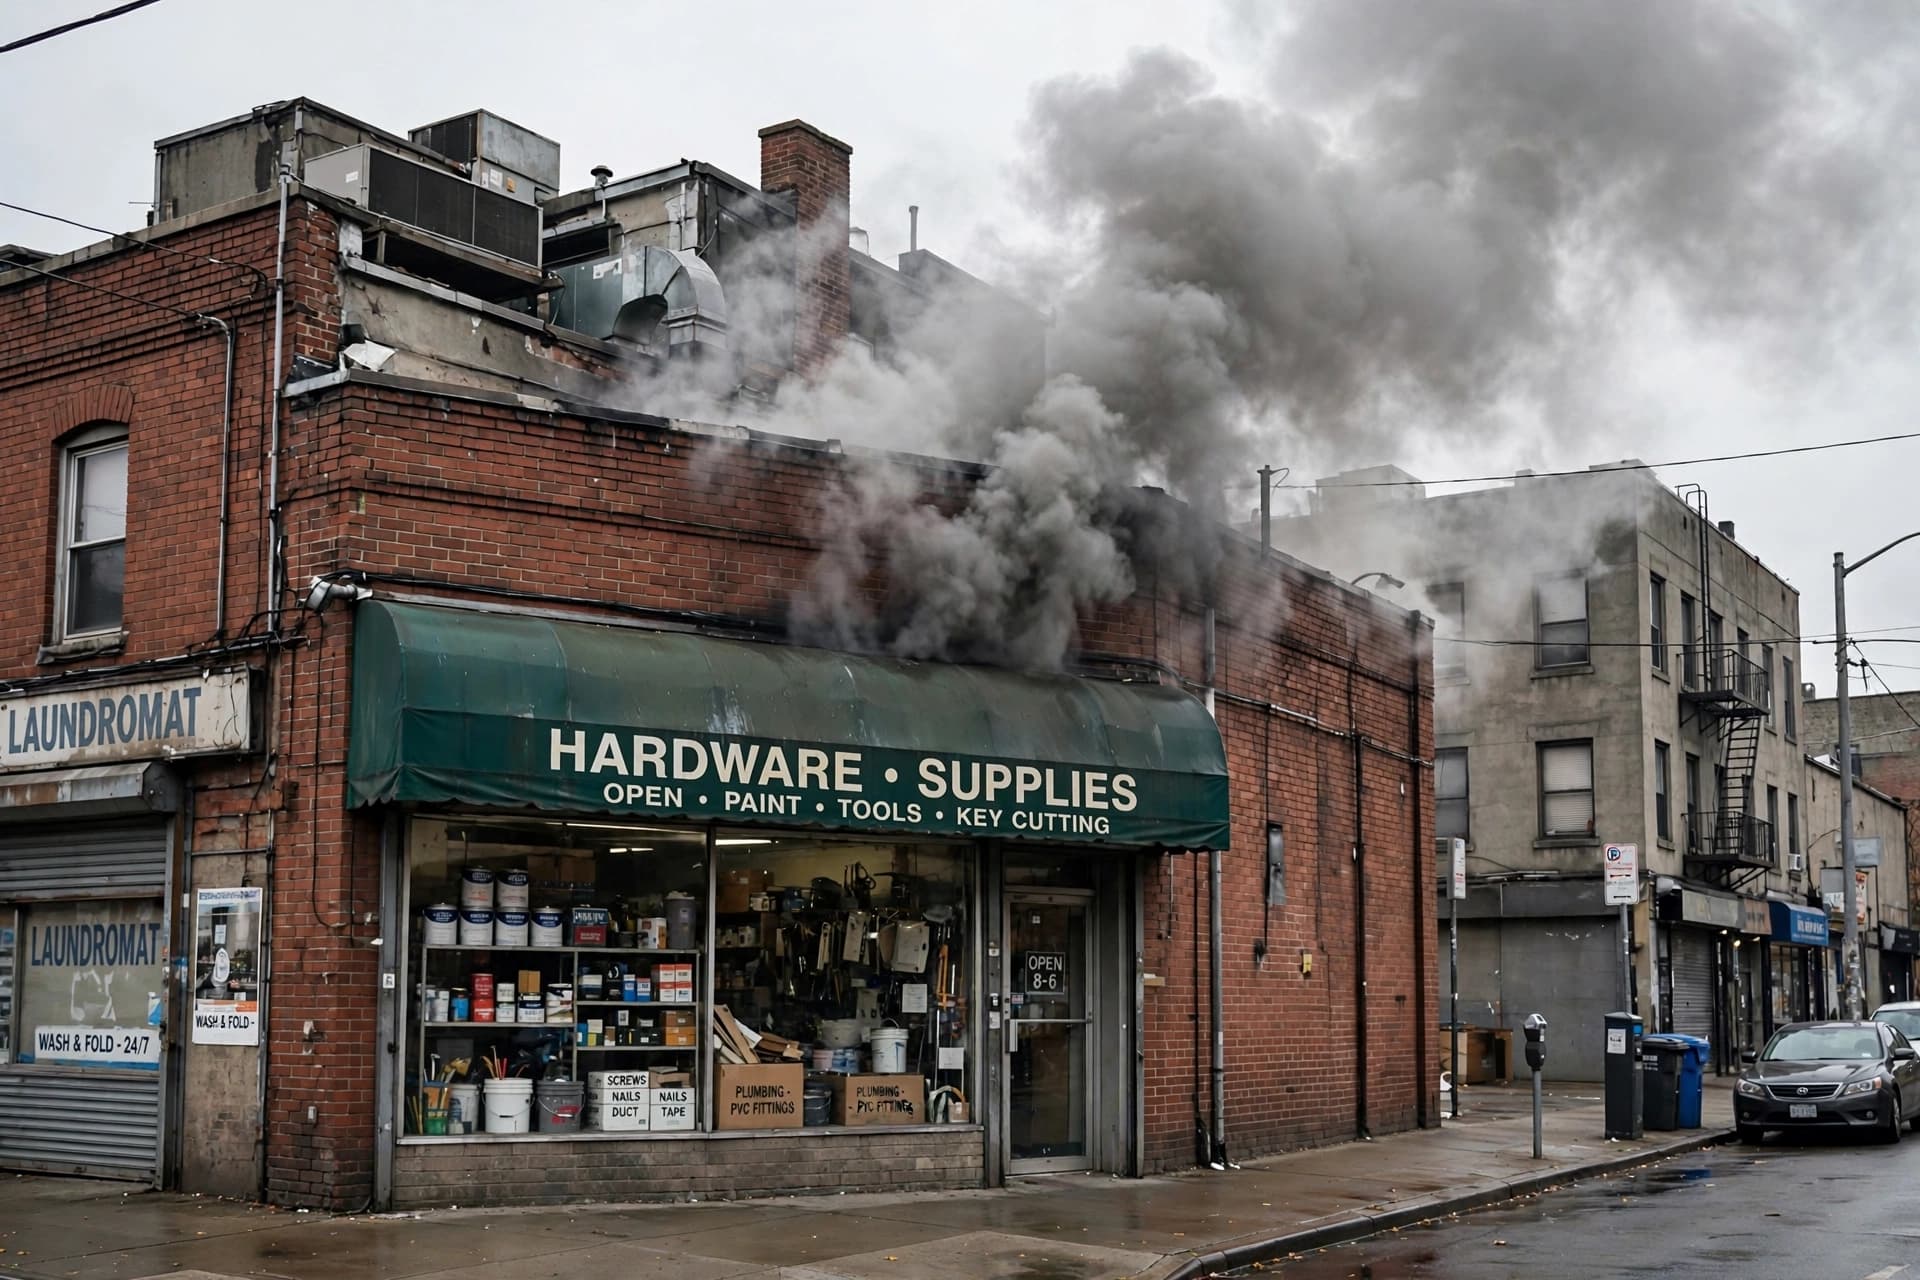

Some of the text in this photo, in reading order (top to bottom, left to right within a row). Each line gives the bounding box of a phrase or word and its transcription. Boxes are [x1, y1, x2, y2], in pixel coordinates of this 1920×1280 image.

[8, 687, 202, 754] LAUNDROMAT
[550, 728, 1138, 812] HARDWARE SUPPLIES
[603, 783, 1110, 835] OPEN PAINT TOOLS KEY CUTTING
[31, 923, 160, 967] LAUNDROMAT
[1028, 955, 1063, 971] OPEN
[1033, 973, 1057, 990] 8-6
[228, 1014, 249, 1029] FOLD
[39, 1033, 70, 1051] WASH
[73, 1034, 81, 1051] &
[85, 1034, 114, 1053] FOLD
[124, 1036, 149, 1055] 24/7
[607, 1075, 647, 1086] SCREWS
[612, 1091, 640, 1102] NAILS
[659, 1091, 687, 1102] NAILS
[735, 1085, 784, 1098] PLUMBING
[856, 1086, 900, 1097] PLUMBING
[612, 1107, 639, 1117] DUCT
[661, 1107, 686, 1117] TAPE
[730, 1100, 795, 1115] PVC FITTINGS
